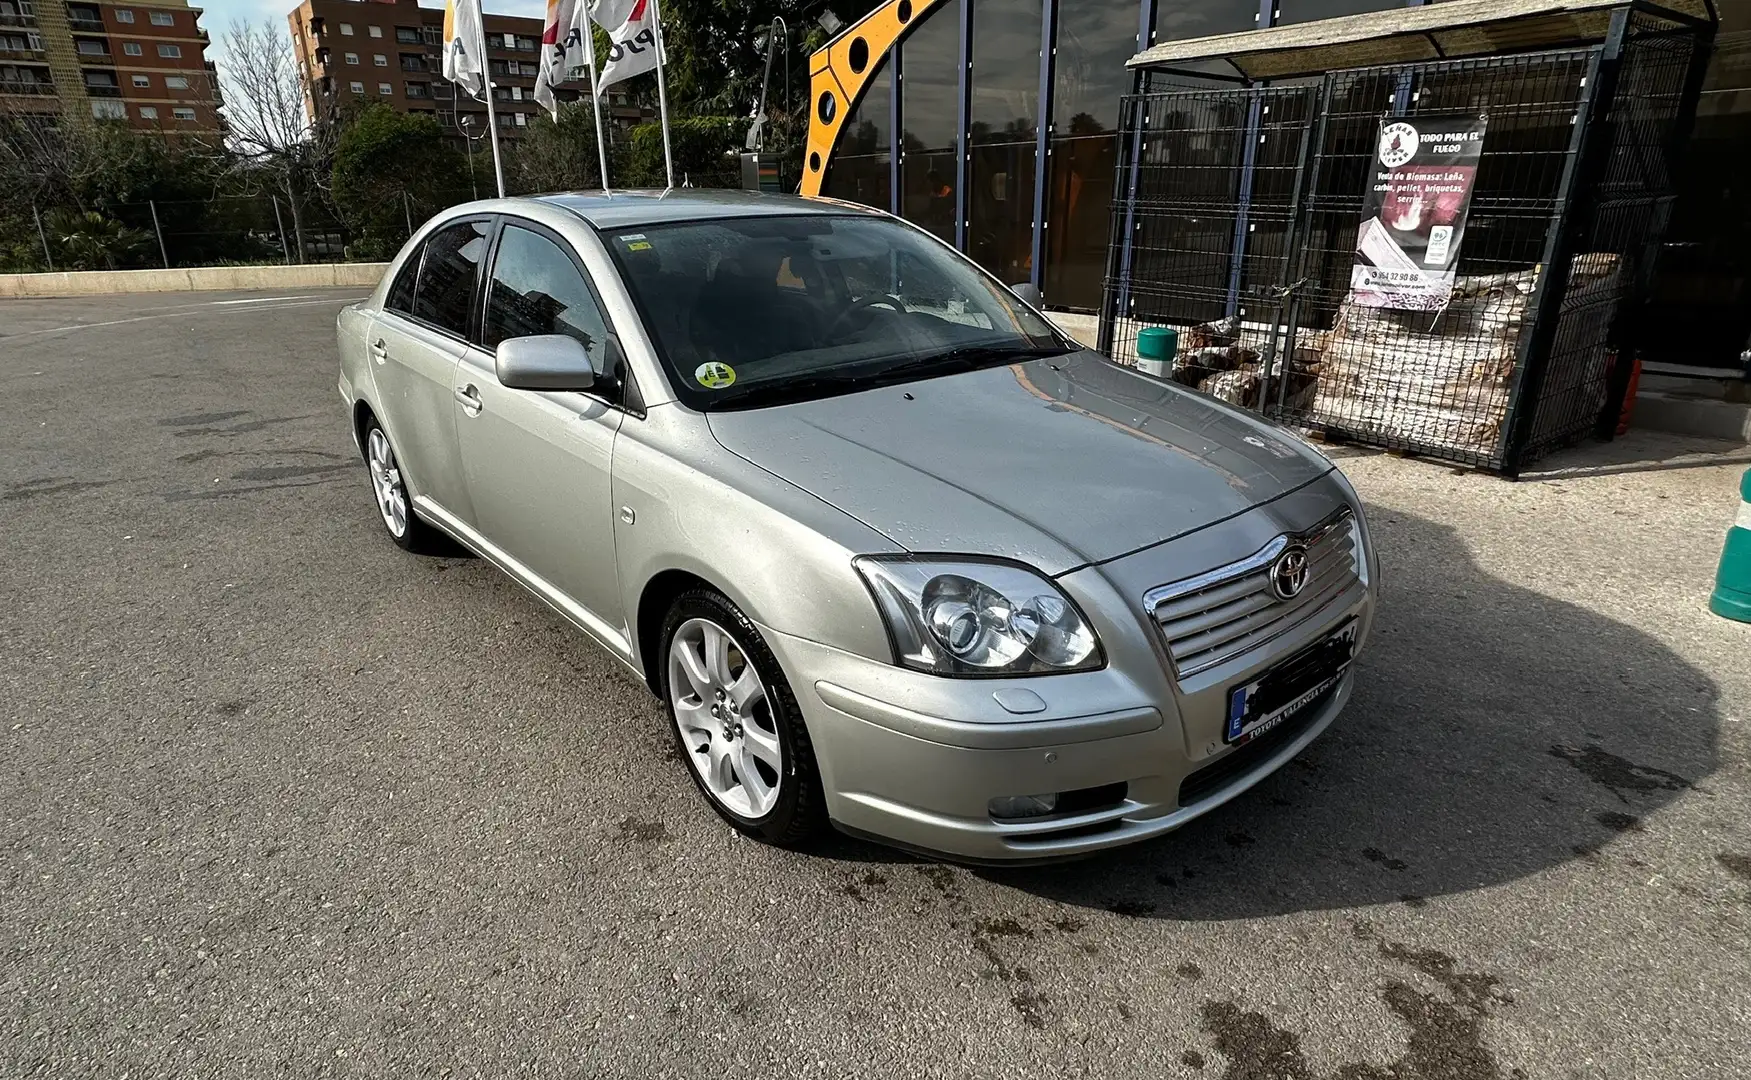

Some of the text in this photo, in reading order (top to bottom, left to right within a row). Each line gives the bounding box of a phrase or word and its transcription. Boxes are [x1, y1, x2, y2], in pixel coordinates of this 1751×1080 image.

[1420, 131, 1479, 143] TODO PARA EL
[1433, 144, 1461, 153] FUEGO
[1394, 172, 1405, 180] de
[1406, 172, 1442, 180] Biomasa:
[1444, 171, 1465, 181] Leña,
[1396, 184, 1422, 193] pellet,
[1424, 184, 1464, 194] briquetas,
[1390, 272, 1399, 281] 32
[1248, 690, 1319, 739] TOYOTA VALENCIA
[1233, 718, 1241, 729] E
